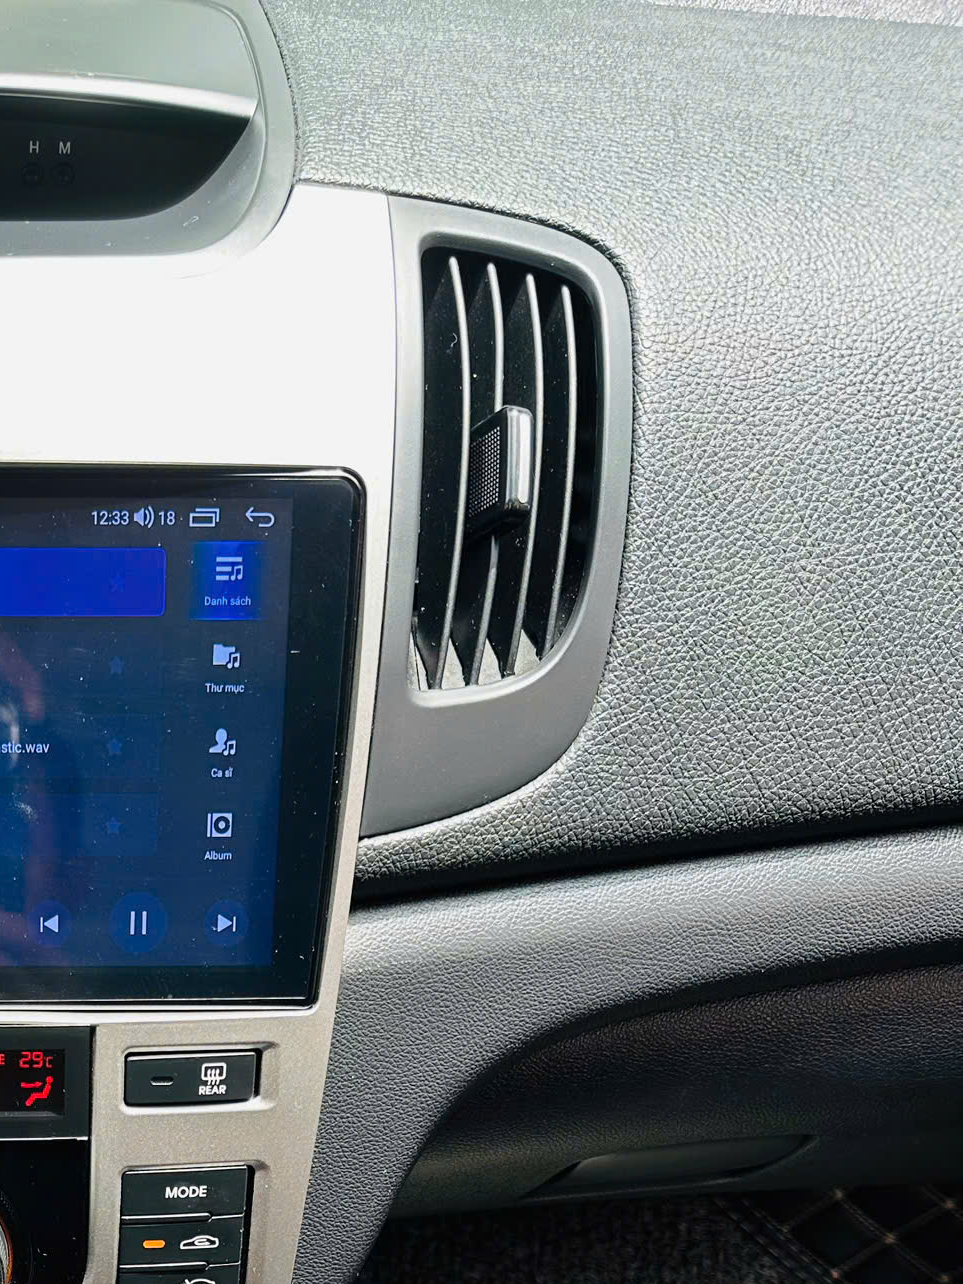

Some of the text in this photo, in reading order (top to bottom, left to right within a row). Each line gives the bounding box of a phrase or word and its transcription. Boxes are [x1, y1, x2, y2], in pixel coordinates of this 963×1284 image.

[29, 140, 71, 155] H M
[91, 511, 129, 526] 12:33
[158, 511, 176, 526] 18
[204, 595, 252, 606] Danh sách
[204, 682, 245, 695] Thư mục
[211, 767, 223, 778] Ca
[204, 850, 233, 861] Album
[198, 1084, 227, 1096] REAR
[164, 1185, 208, 1199] MODE
